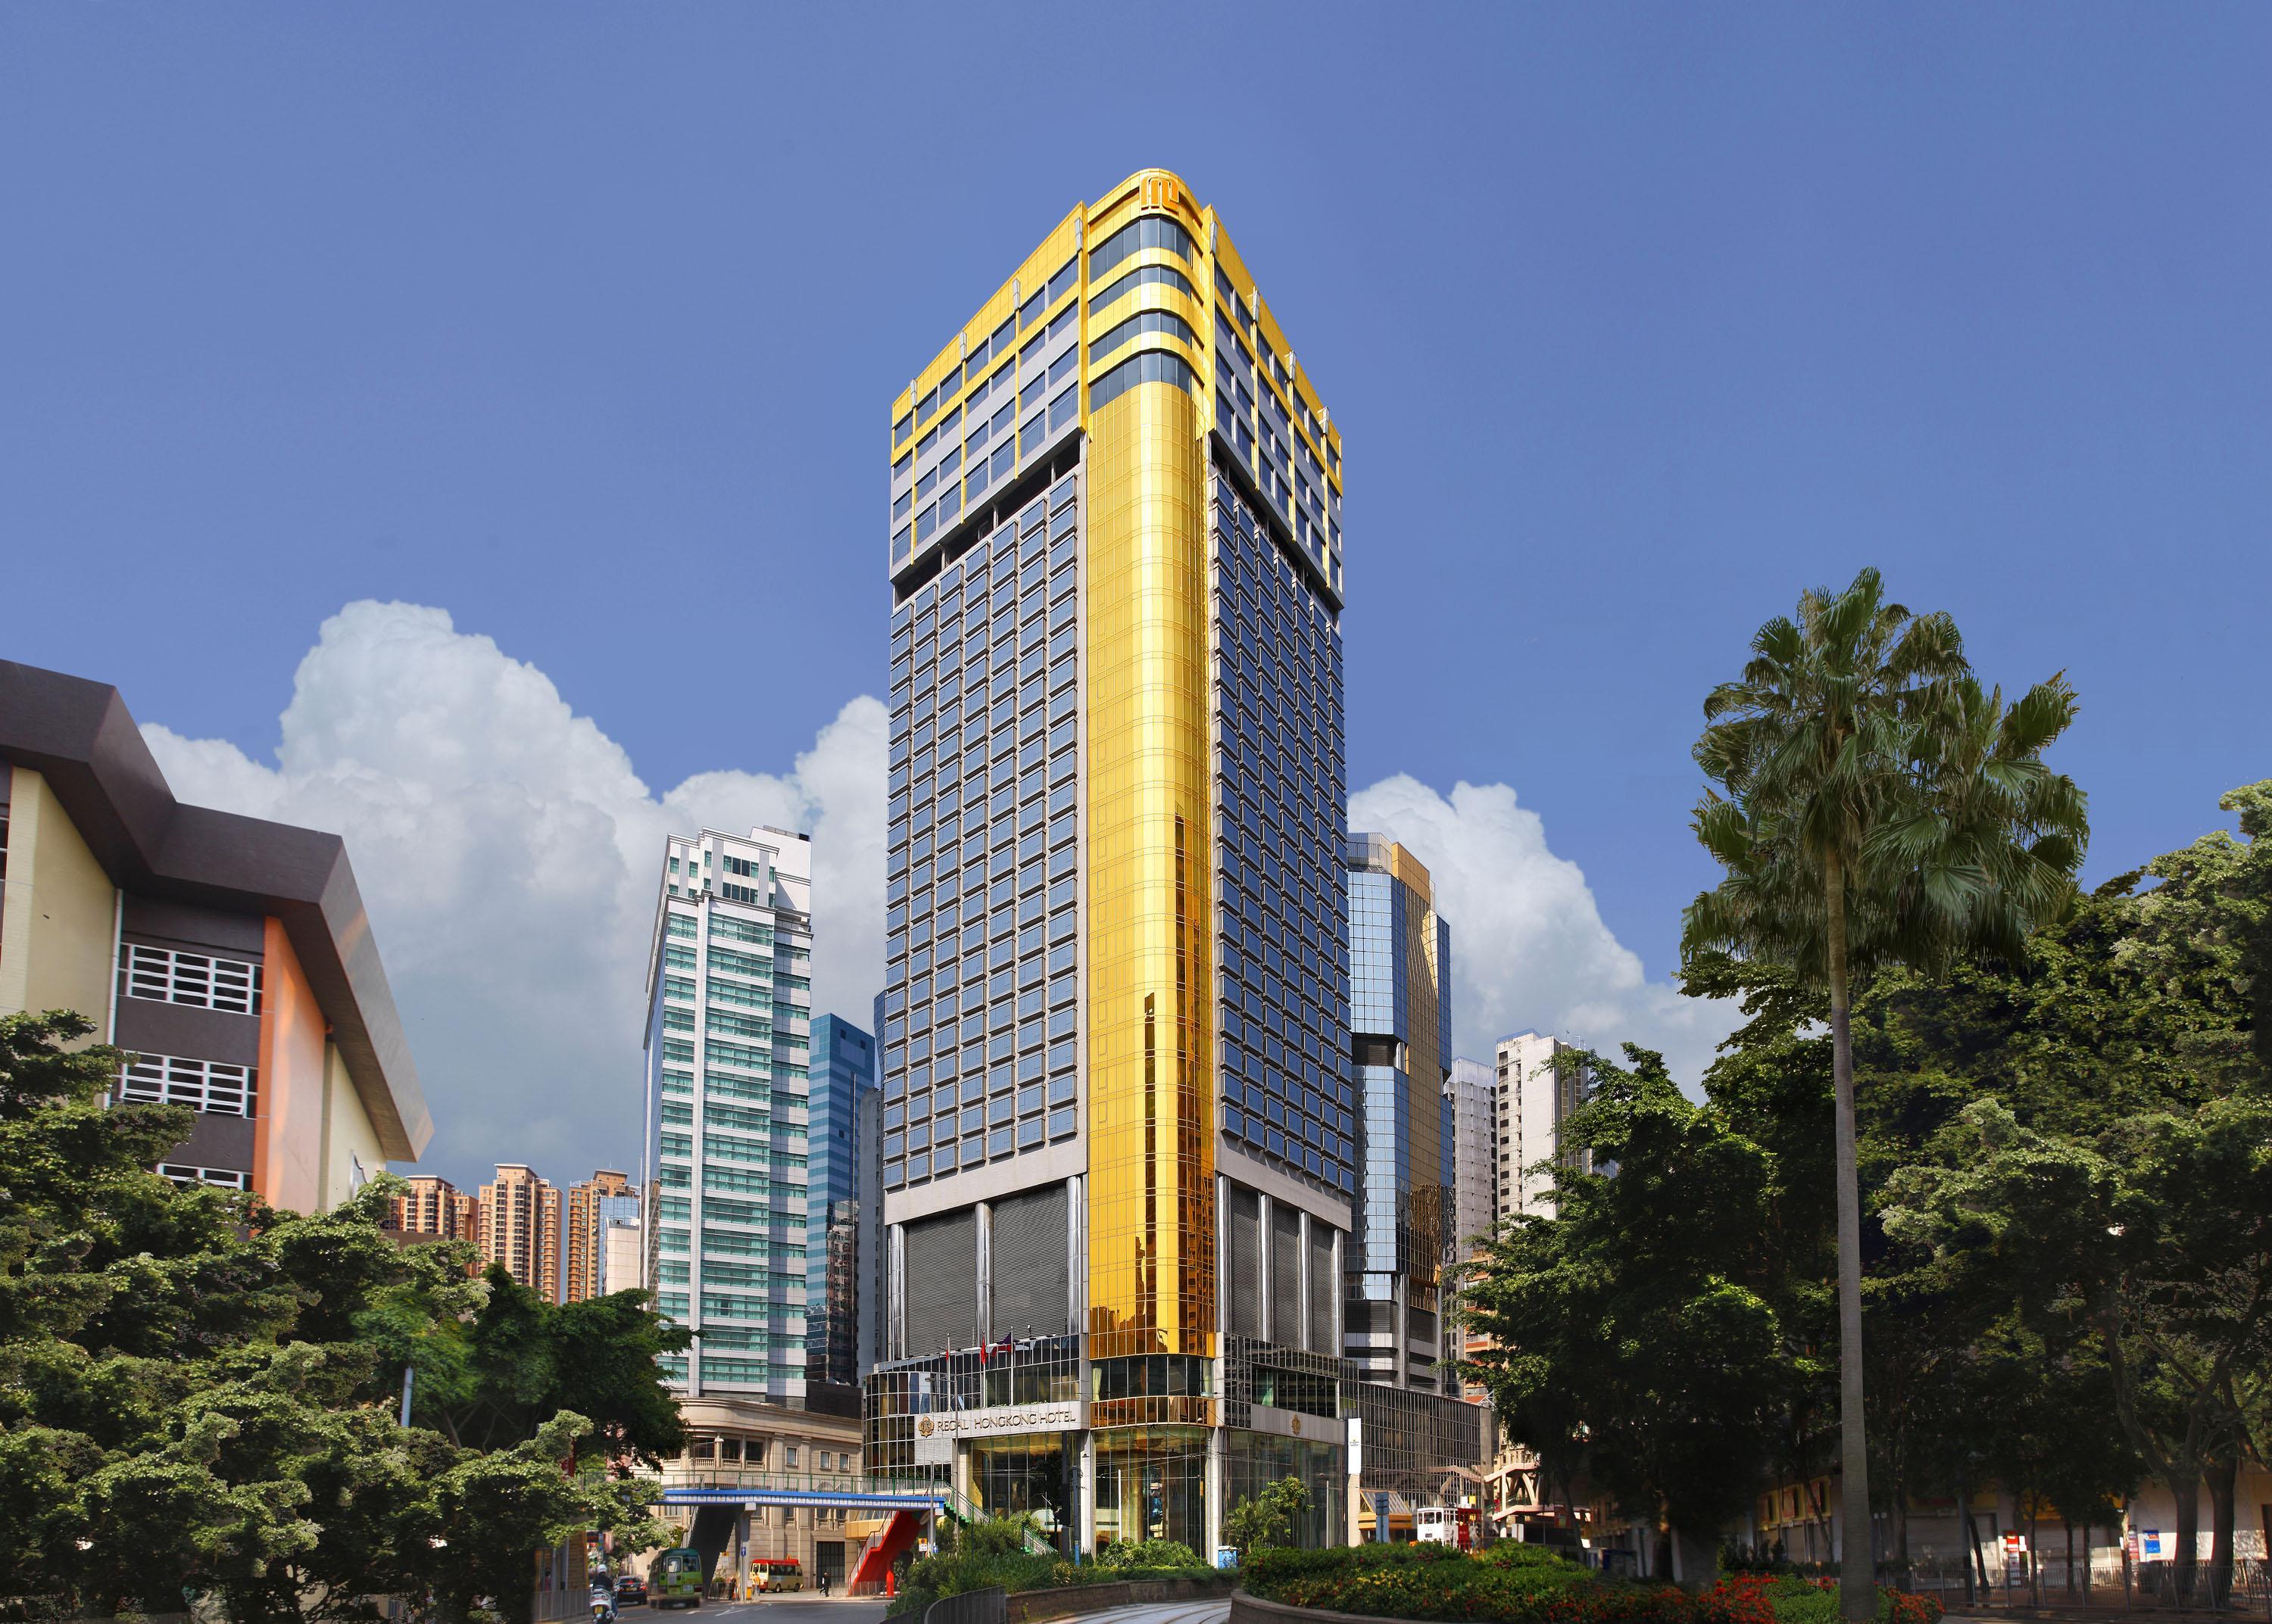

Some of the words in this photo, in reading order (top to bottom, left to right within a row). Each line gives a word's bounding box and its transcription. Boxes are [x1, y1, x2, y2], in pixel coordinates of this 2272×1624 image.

[937, 1419, 969, 1432] REGAL
[974, 1413, 1037, 1429] HONGKONG
[1039, 1410, 1076, 1424] HOTEL
